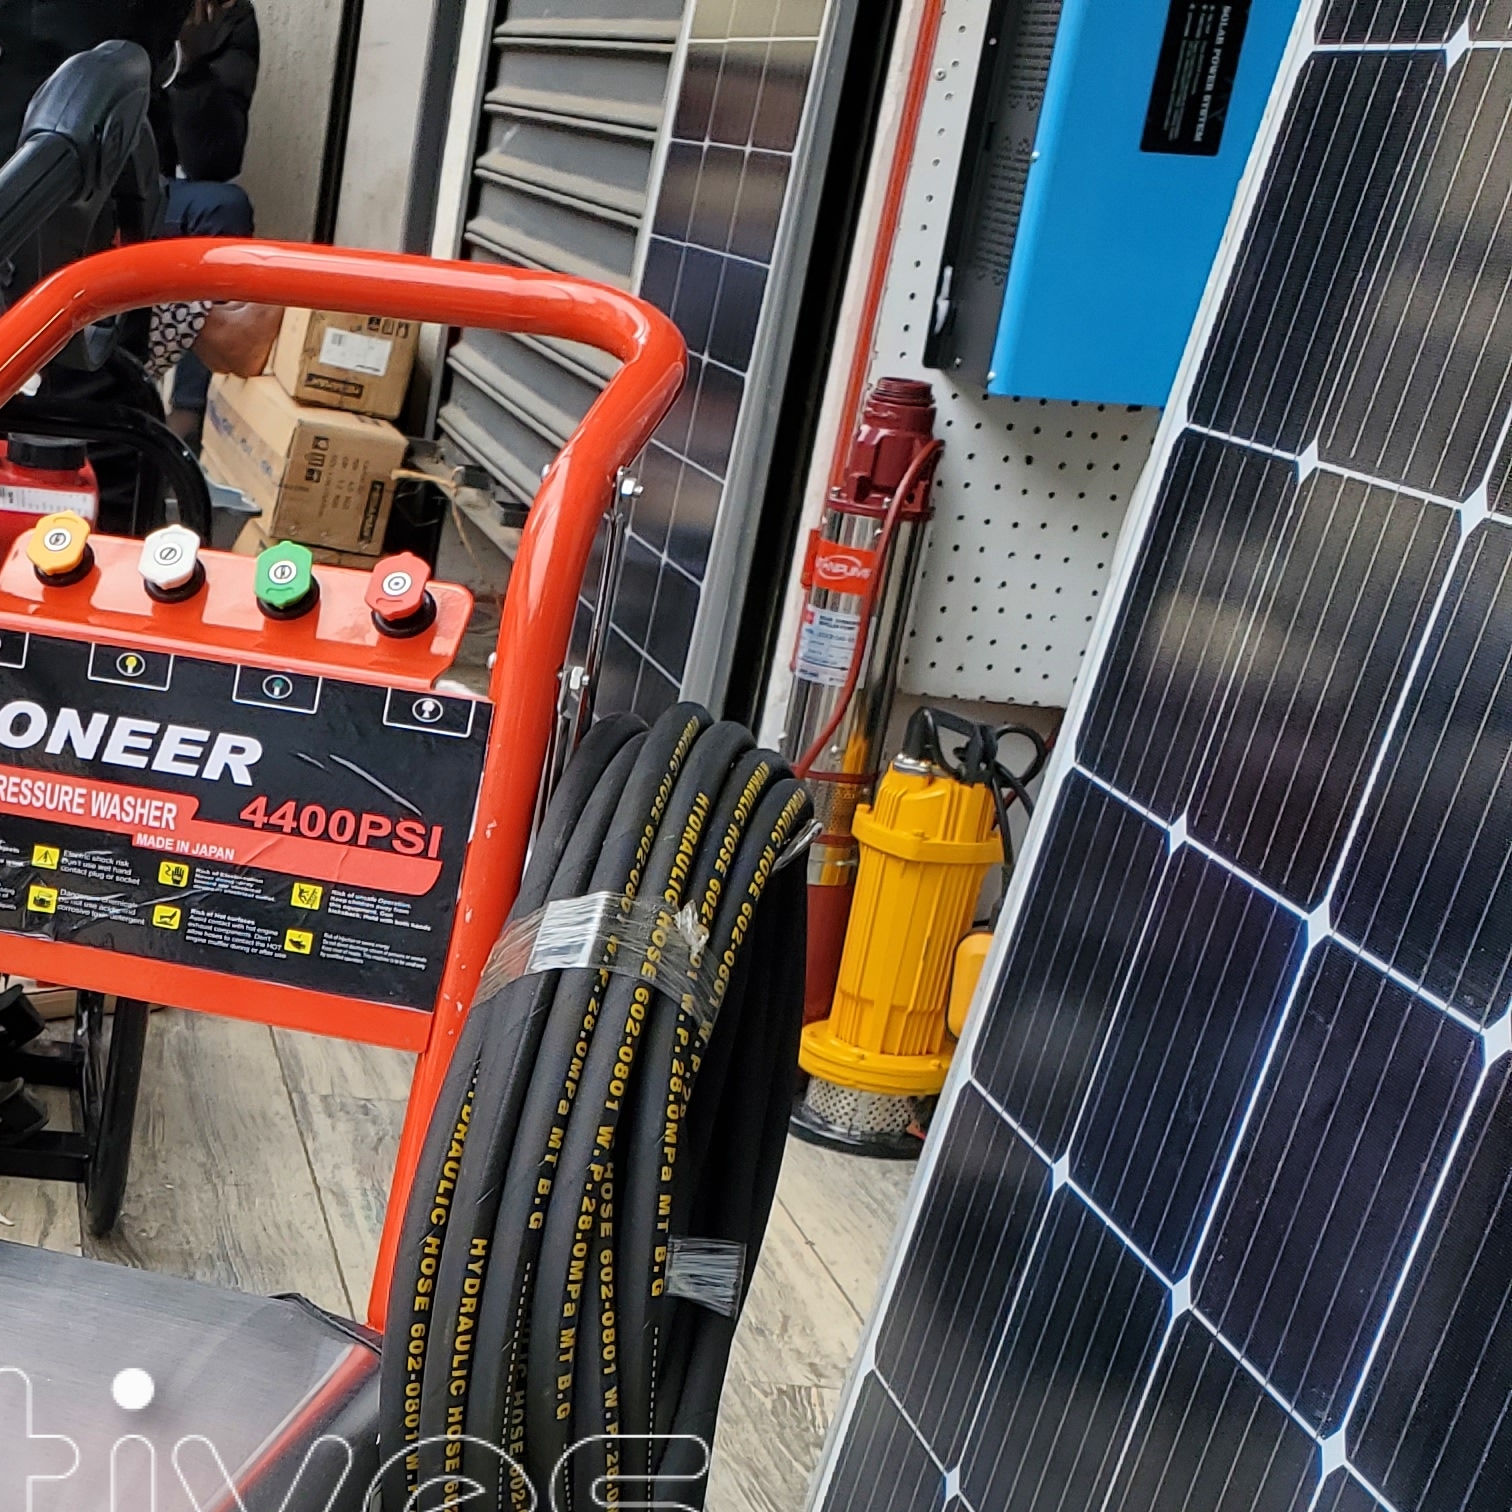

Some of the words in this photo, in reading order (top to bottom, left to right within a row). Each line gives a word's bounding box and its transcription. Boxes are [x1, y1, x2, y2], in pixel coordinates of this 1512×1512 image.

[90, 790, 178, 830] WASHER
[650, 772, 673, 824] HOSE
[136, 833, 174, 852] MADE
[176, 838, 189, 853] IN
[191, 842, 235, 861] JAPAN
[240, 796, 444, 858] 4400PSI
[664, 792, 711, 908] HYDRAULIC
[715, 822, 740, 879] HOSE
[59, 864, 87, 877] contact
[87, 869, 104, 880] plug
[115, 858, 129, 867] risk
[748, 844, 776, 901] HOSE
[640, 911, 674, 982] HOSE
[605, 987, 650, 1112] 602-0801
[544, 1126, 564, 1168] MT
[529, 1178, 552, 1230] B.G
[657, 1194, 672, 1233] MT
[414, 1237, 441, 1312] HOSE
[651, 1246, 668, 1297] B.G
[450, 1238, 488, 1397] HYDRAULIC
[599, 1249, 617, 1375] 602-0801
[559, 1327, 576, 1363] MT
[405, 1323, 426, 1441] 602-0801
[556, 1373, 572, 1420] B.G
[445, 1406, 464, 1473] HOSE
